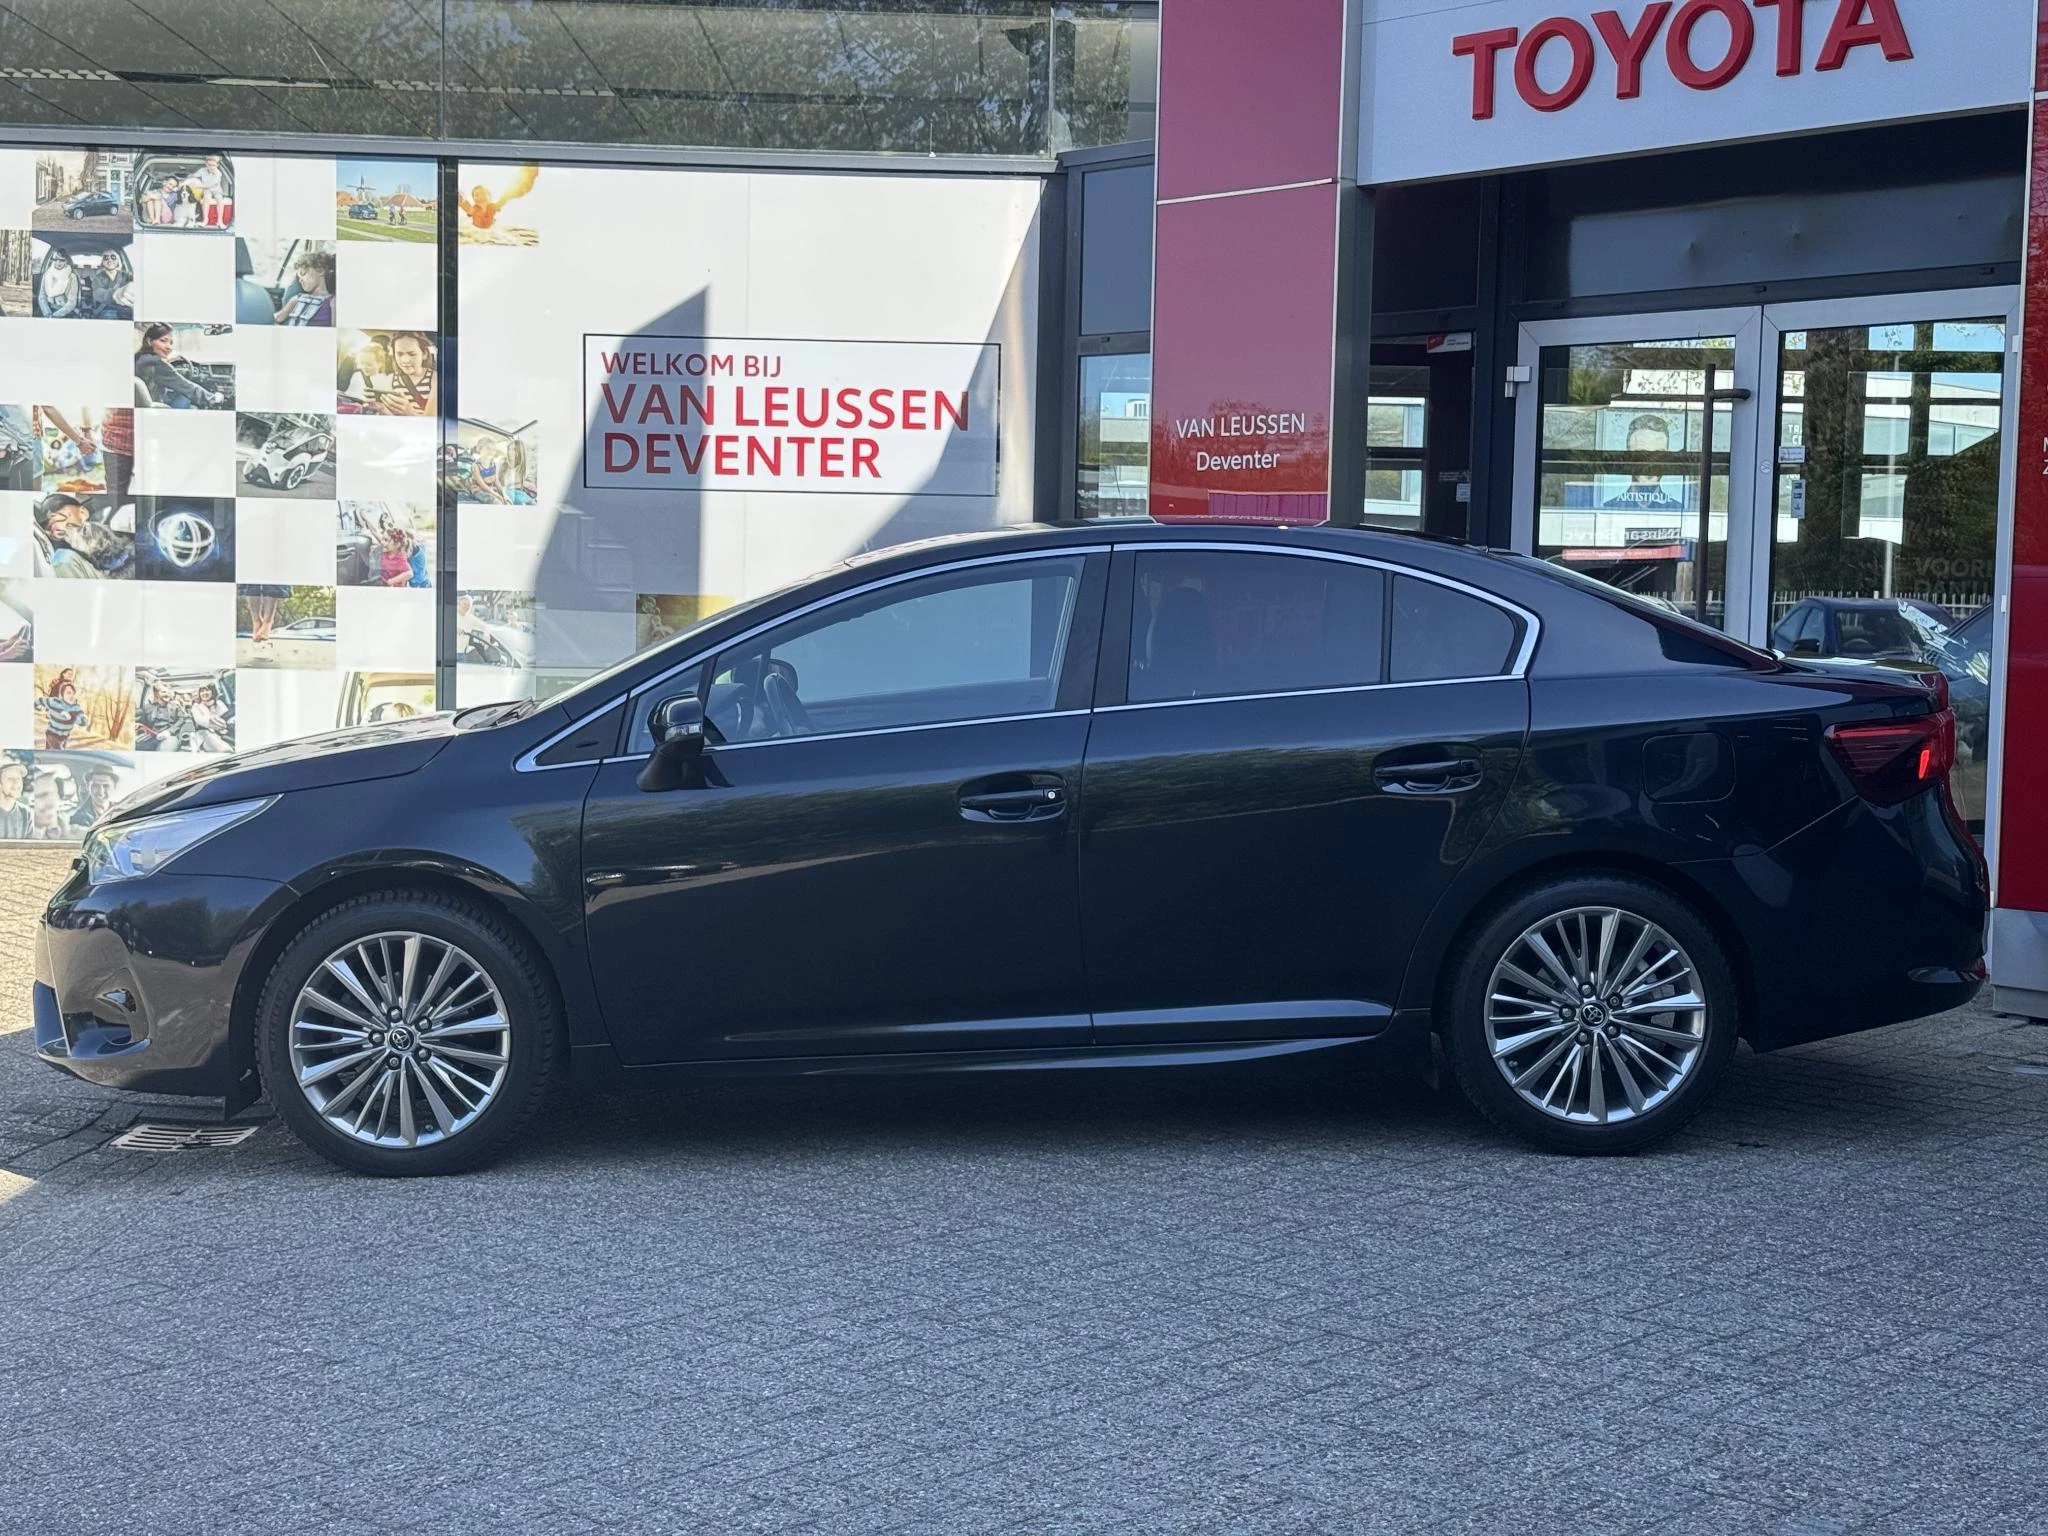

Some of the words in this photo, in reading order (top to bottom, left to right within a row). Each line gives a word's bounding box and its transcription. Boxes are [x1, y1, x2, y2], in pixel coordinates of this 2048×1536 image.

[1452, 0, 1914, 121] TOYOTA
[601, 352, 734, 376] WELKOM
[744, 355, 782, 378] BIJ
[601, 383, 715, 426] VAN
[735, 386, 969, 432] LEUSSEN
[1176, 417, 1215, 439] VAN
[1220, 413, 1305, 437] LEUSSEN
[604, 432, 882, 478] DEVENTER
[1196, 451, 1281, 472] Deventer
